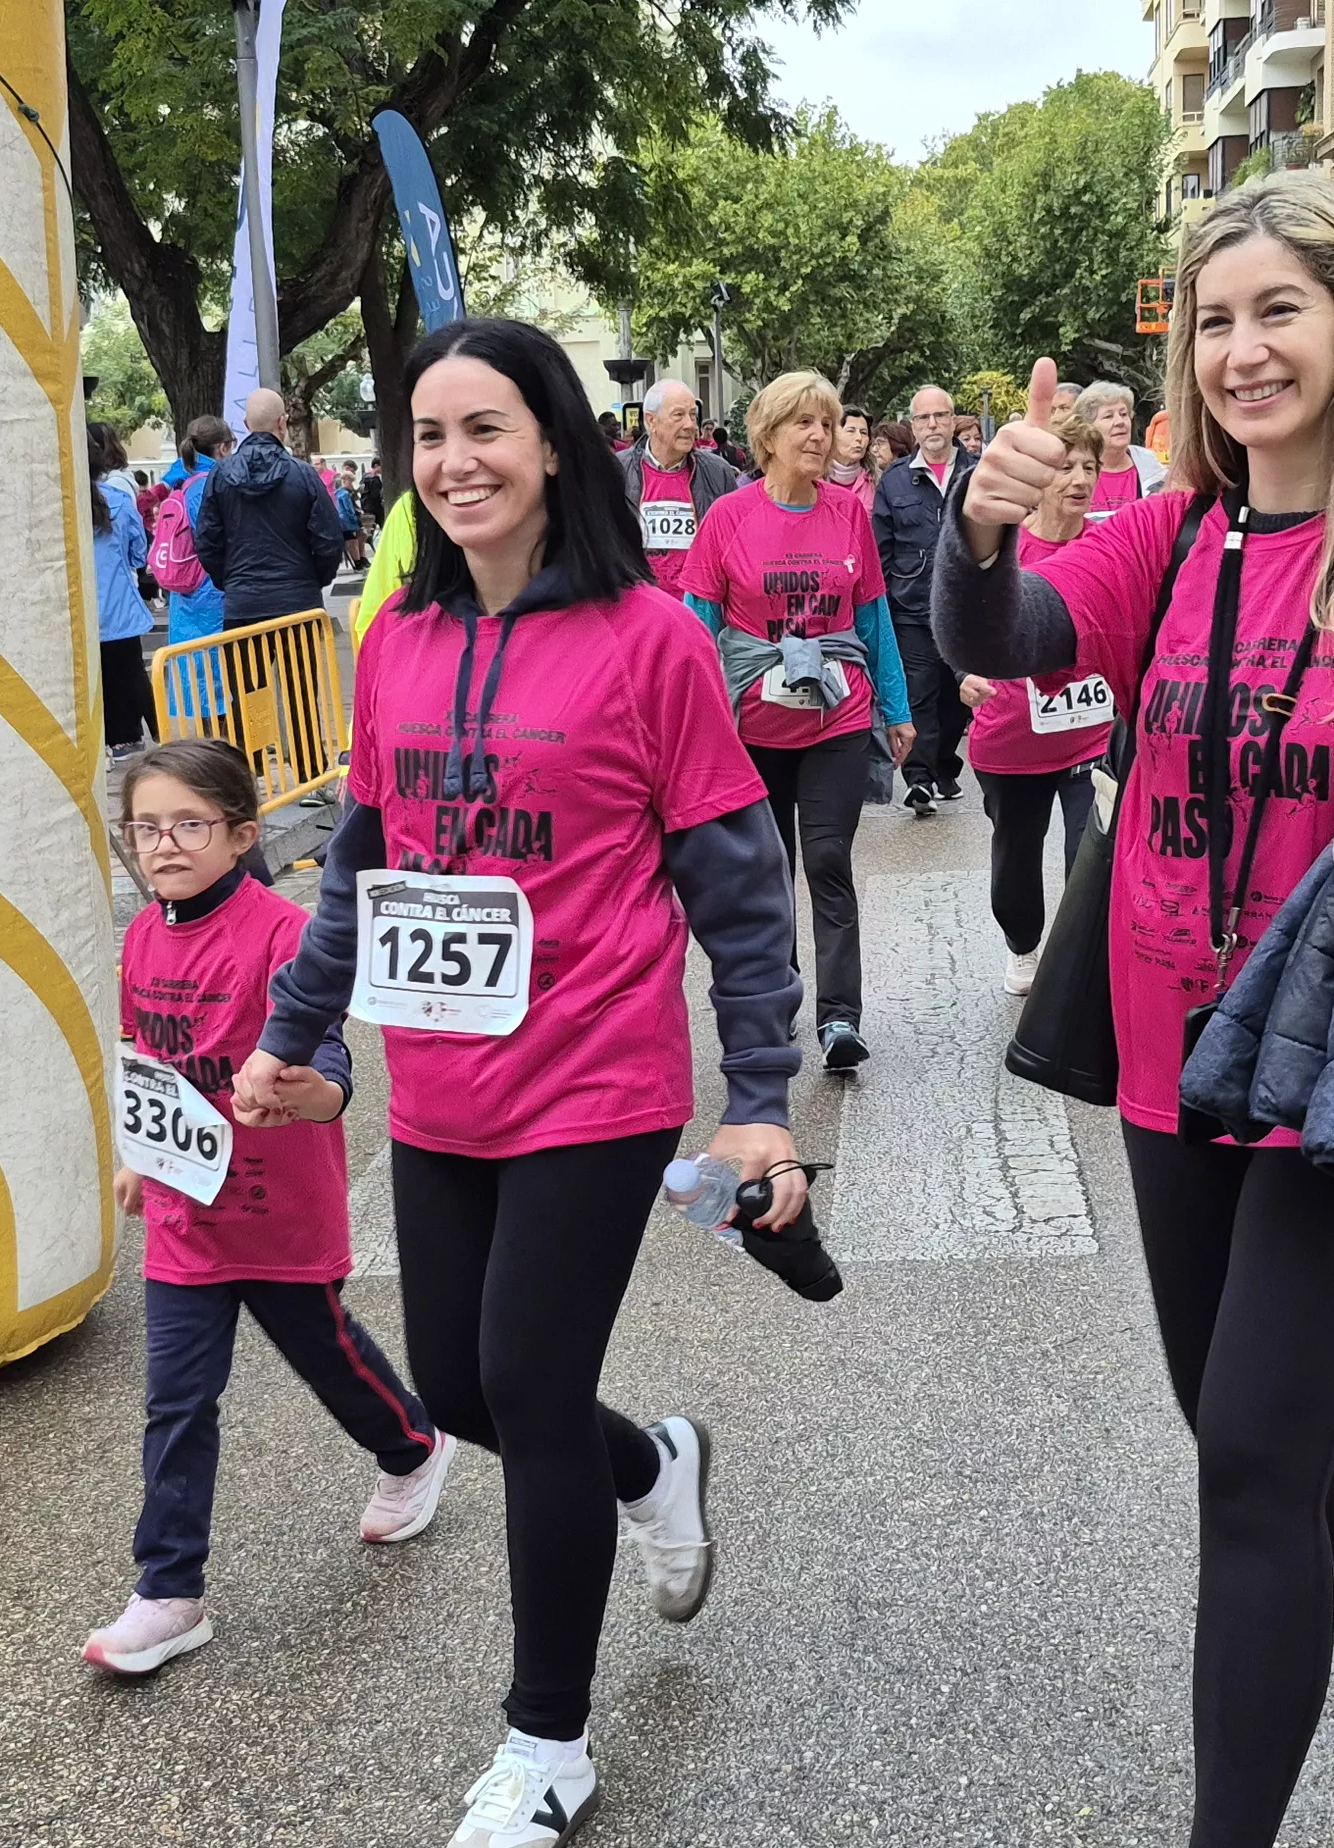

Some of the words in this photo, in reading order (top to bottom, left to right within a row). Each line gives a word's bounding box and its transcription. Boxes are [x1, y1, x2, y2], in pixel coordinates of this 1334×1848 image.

[647, 517, 696, 535] 1028
[763, 571, 820, 595] UNIDOS
[787, 594, 805, 617] EN
[1270, 655, 1288, 668] EL
[1039, 680, 1108, 713] 2146
[475, 808, 554, 862] CADA
[380, 901, 433, 920] CONTRA
[451, 904, 512, 922] CÁNCER
[378, 926, 512, 988] 1257
[124, 1089, 218, 1161] 3306
